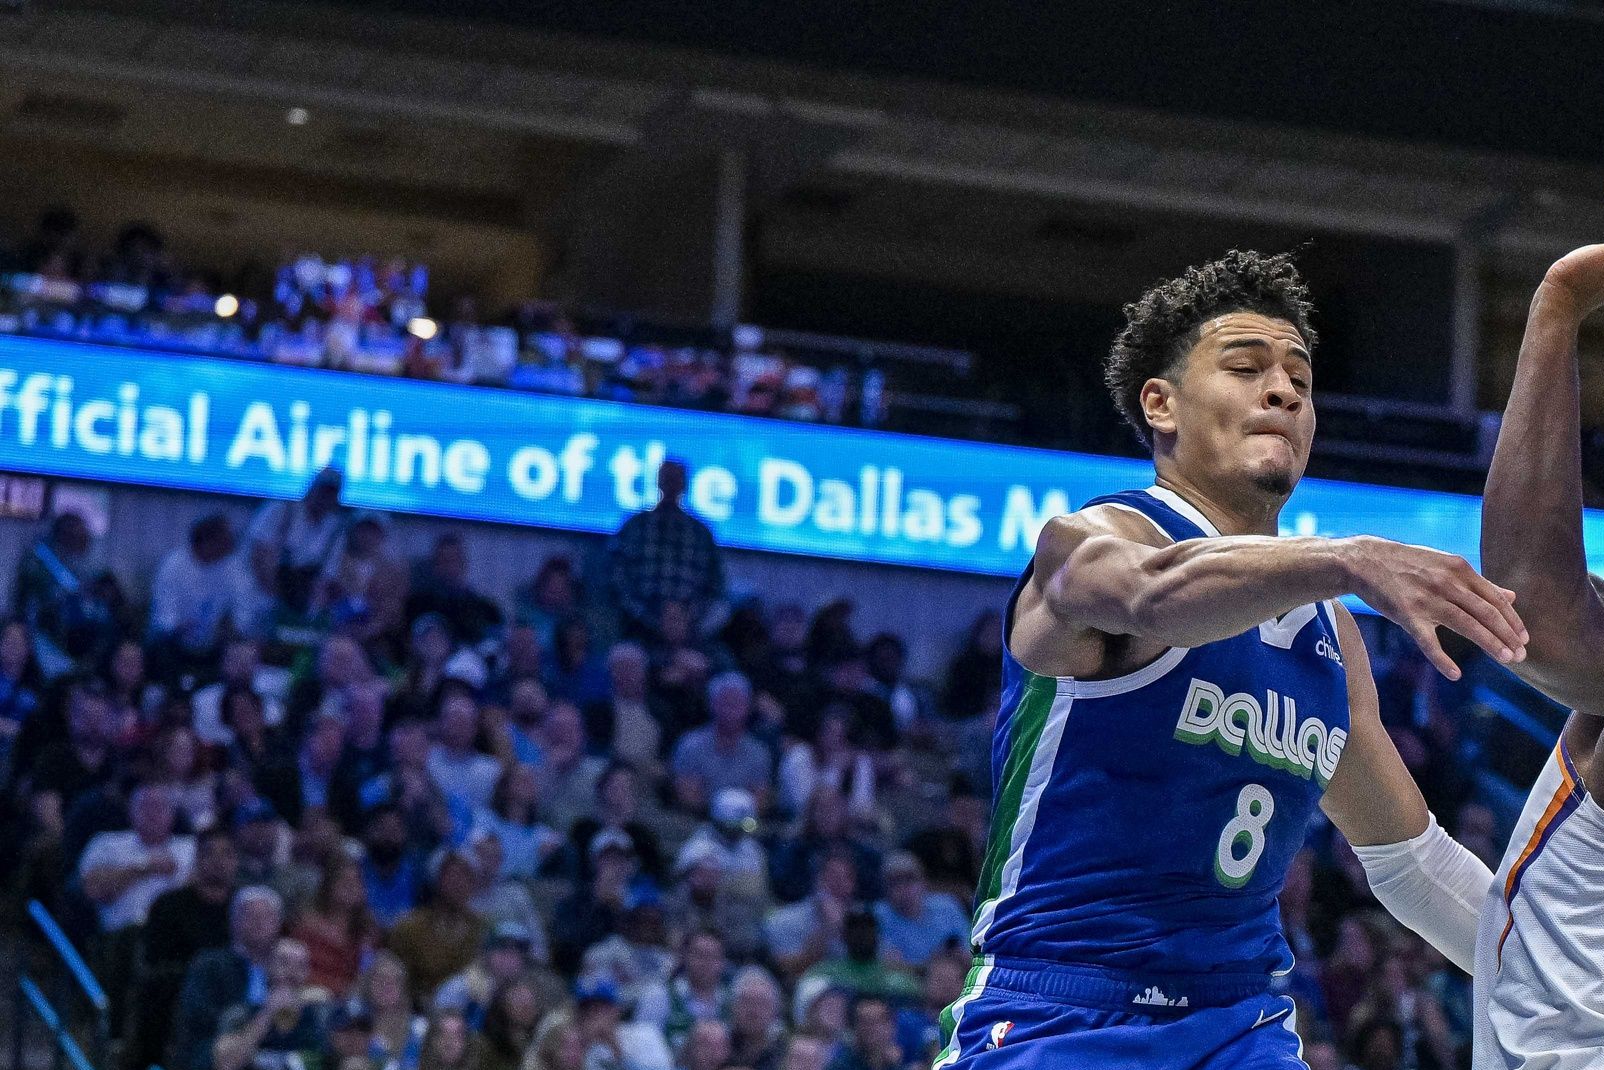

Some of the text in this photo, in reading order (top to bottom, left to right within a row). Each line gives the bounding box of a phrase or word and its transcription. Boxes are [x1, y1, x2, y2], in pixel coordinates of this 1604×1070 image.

[0, 369, 209, 463] ficial
[226, 402, 490, 493] Airline
[507, 432, 598, 502] of
[758, 458, 982, 546] Dallas
[1173, 677, 1347, 790] Dallas
[1214, 783, 1275, 889] 8
